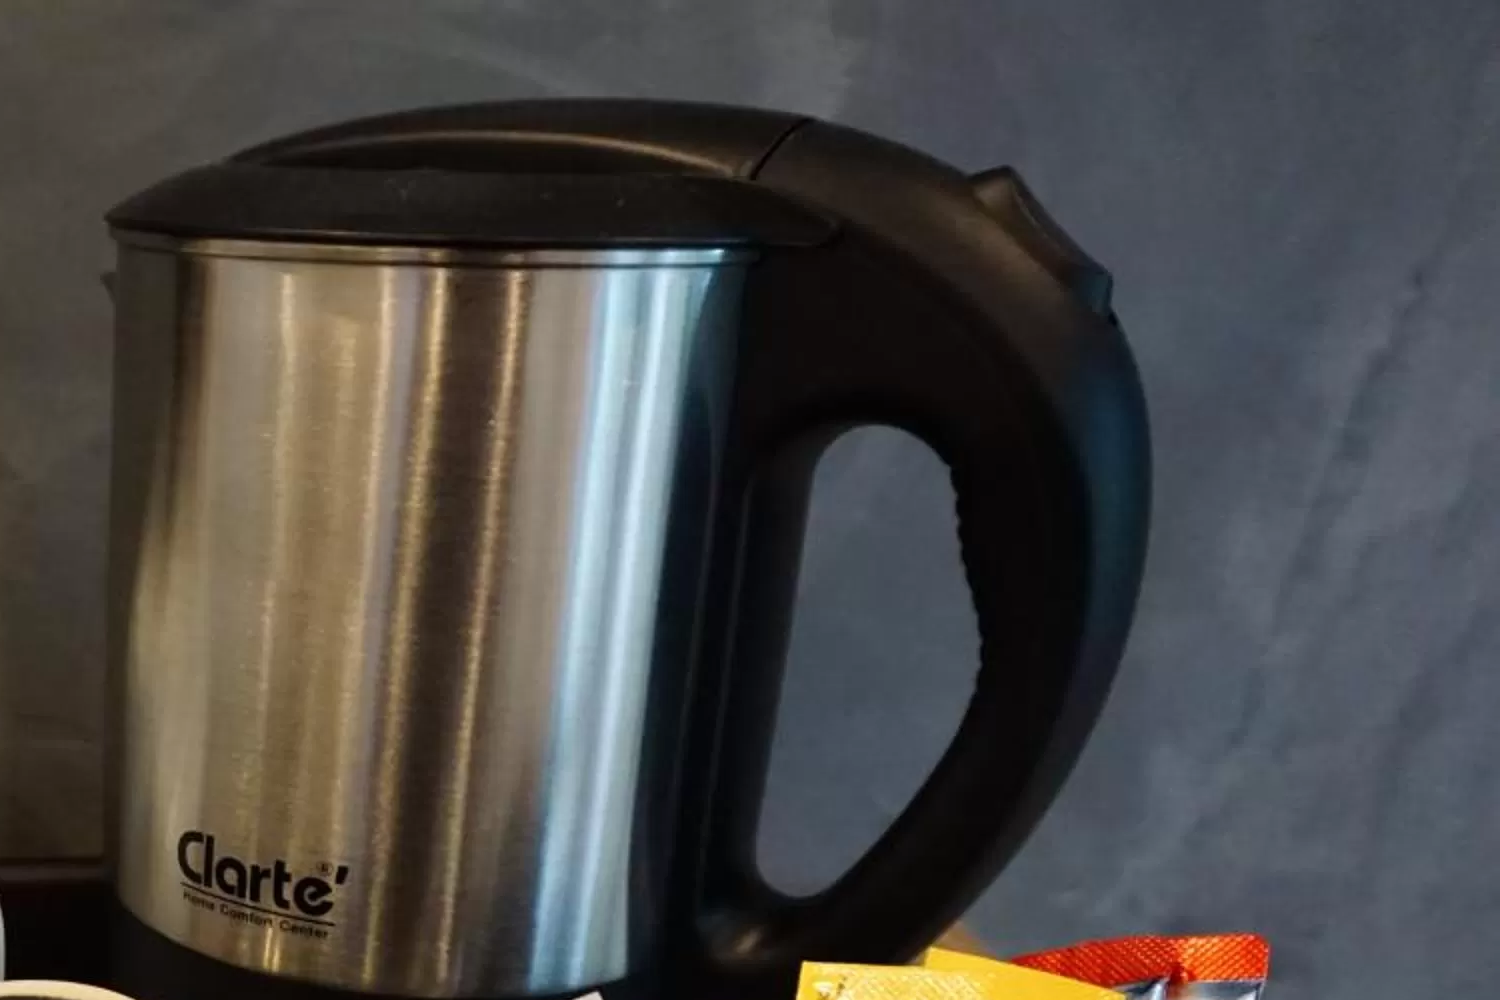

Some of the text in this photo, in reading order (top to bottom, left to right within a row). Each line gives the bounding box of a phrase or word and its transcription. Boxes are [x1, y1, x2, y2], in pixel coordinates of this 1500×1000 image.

[183, 890, 329, 939] Home Comfort Center
